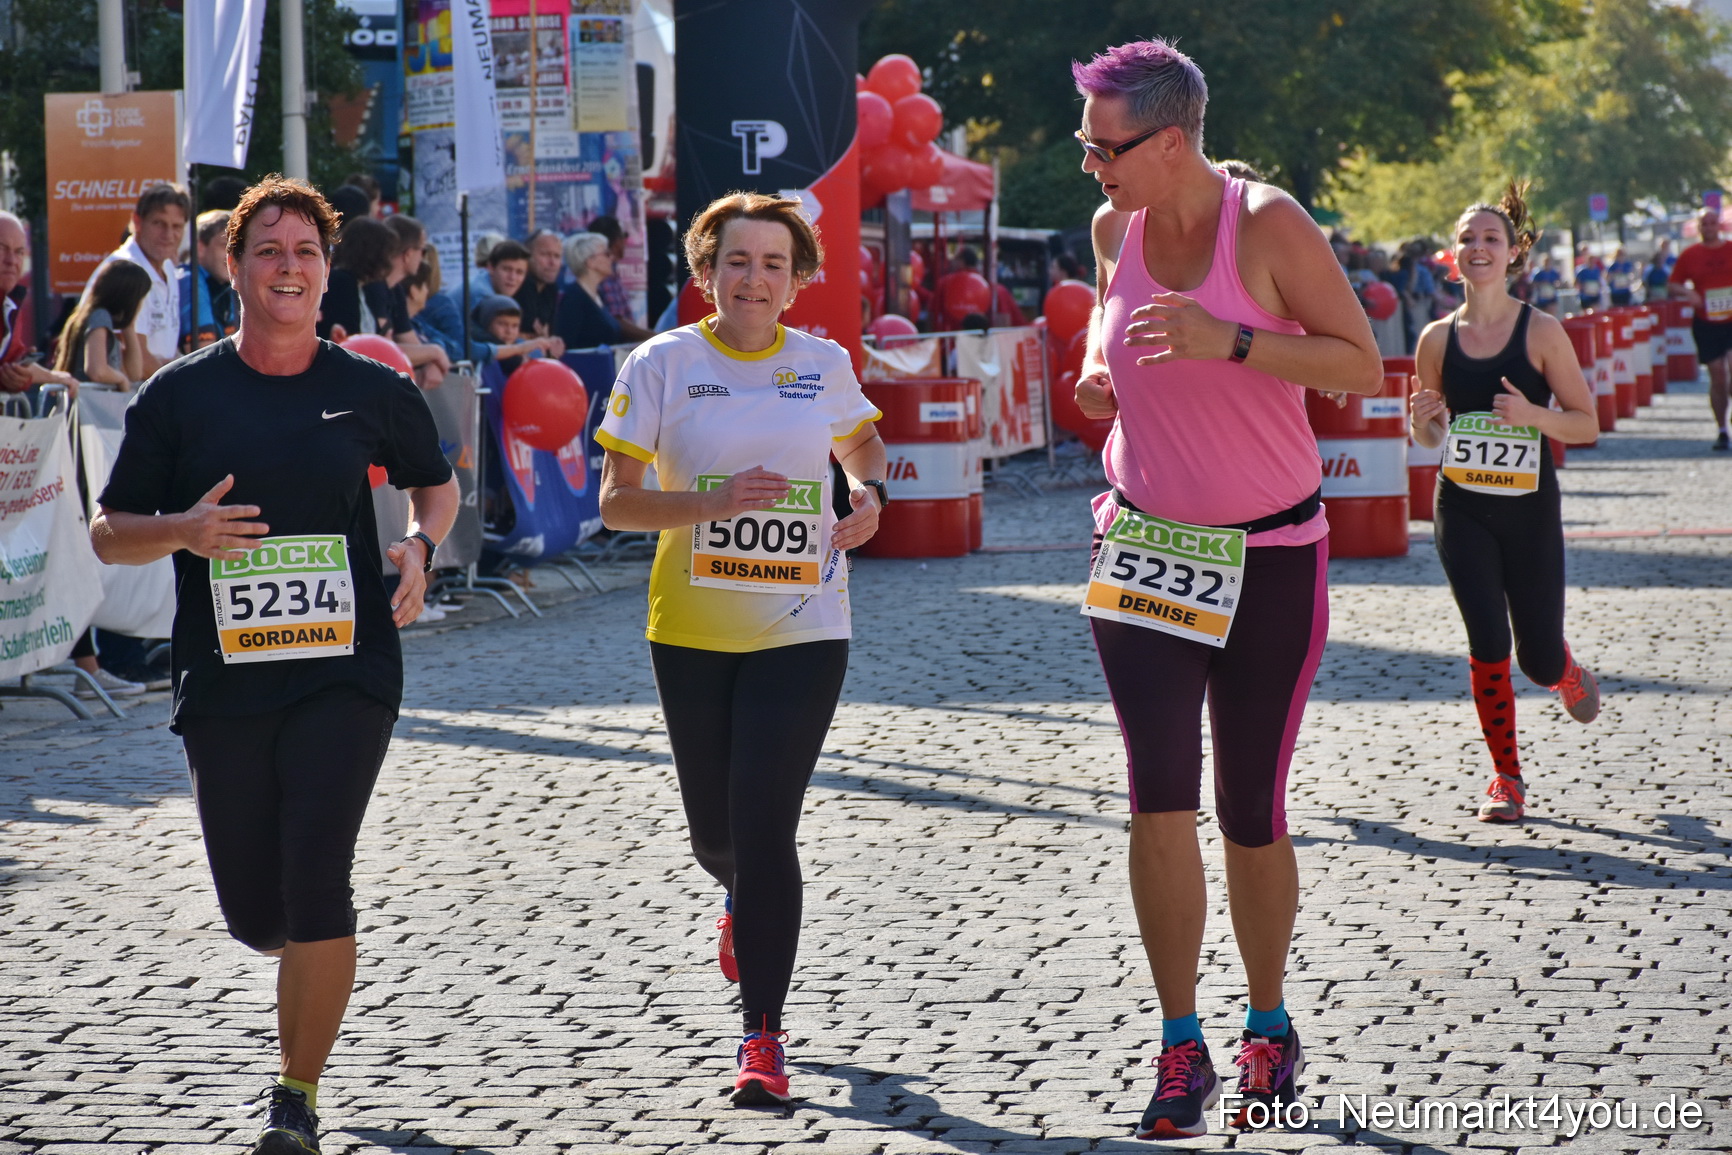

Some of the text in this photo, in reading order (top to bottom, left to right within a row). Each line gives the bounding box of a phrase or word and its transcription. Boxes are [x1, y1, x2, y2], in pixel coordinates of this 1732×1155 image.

[688, 384, 729, 395] BOCK
[775, 372, 797, 386] 20
[1455, 439, 1528, 467] 5127
[1466, 472, 1514, 485] SARAH
[709, 517, 808, 554] 5009
[1115, 515, 1232, 562] BOCK
[222, 541, 338, 575] BOCK
[711, 560, 802, 581] SUSANNE
[1110, 551, 1223, 606] 5232
[229, 579, 339, 621] 5234
[1118, 594, 1198, 626] DENISE
[238, 627, 338, 648] GORDANA
